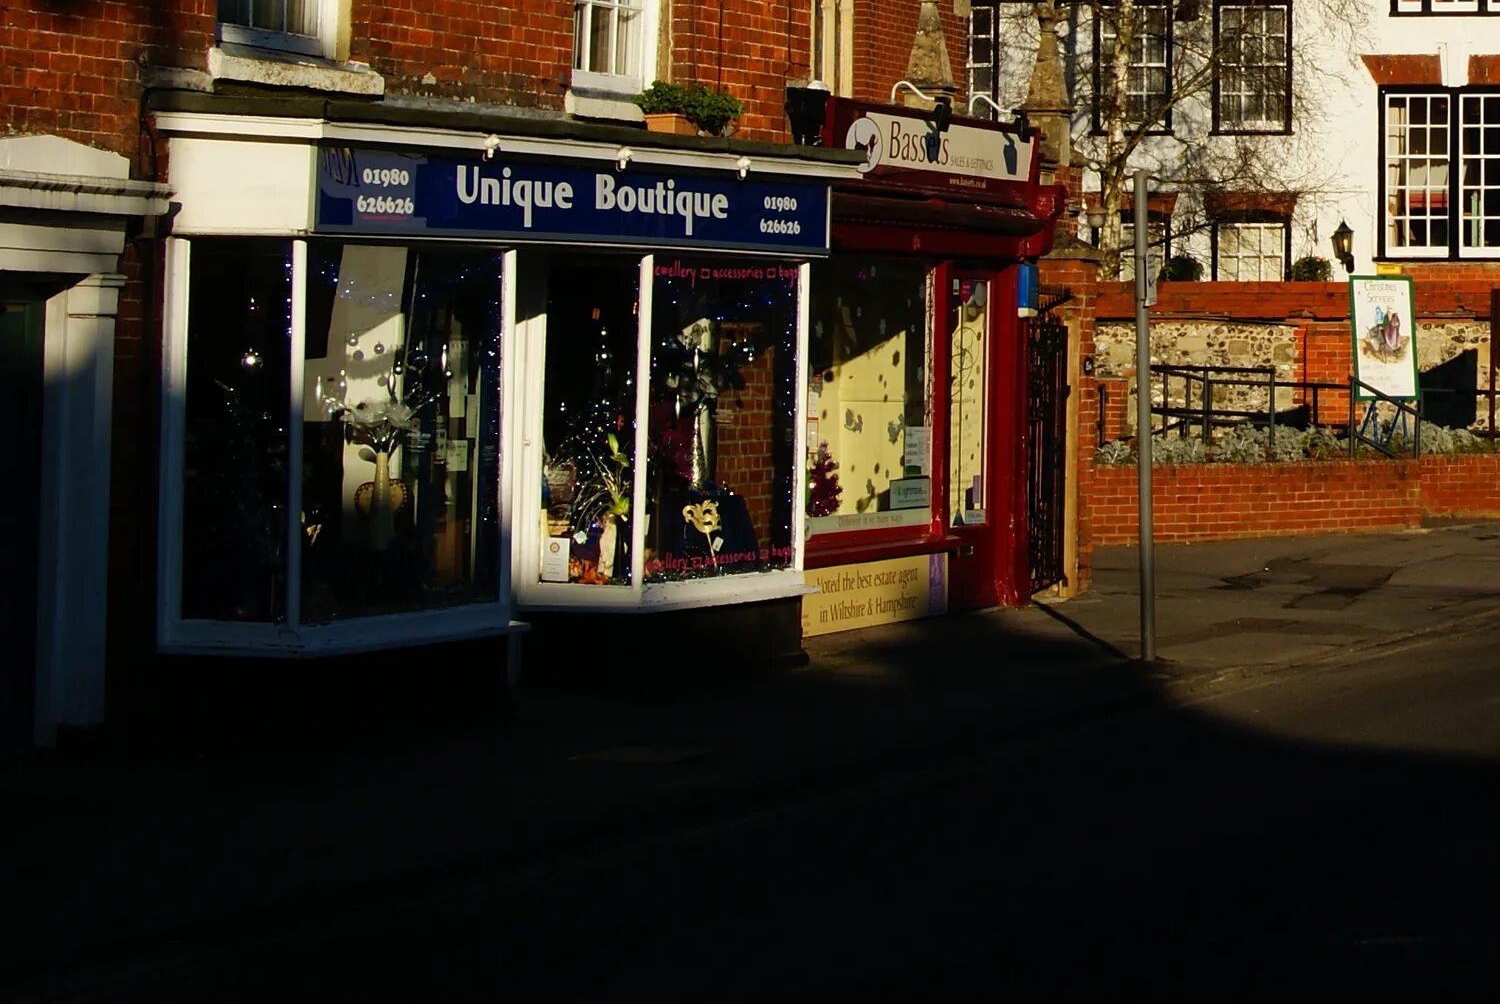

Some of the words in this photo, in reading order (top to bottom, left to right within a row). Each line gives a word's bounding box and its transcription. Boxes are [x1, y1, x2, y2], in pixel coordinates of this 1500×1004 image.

[363, 168, 409, 188] 01980
[356, 194, 415, 215] 626626
[456, 164, 574, 228] Unique
[595, 173, 729, 236] Boutique
[763, 195, 798, 212] 01980
[759, 217, 801, 235] 626626
[654, 259, 697, 289] ewellery
[711, 265, 764, 280] accessories
[816, 571, 841, 595] Voted
[842, 571, 854, 591] the
[856, 569, 872, 590] best
[873, 570, 897, 587] estate
[898, 567, 919, 590] agent
[819, 605, 828, 624] in
[829, 598, 866, 622] Wiltshire
[867, 597, 873, 616] &
[875, 591, 917, 619] Hampshire
